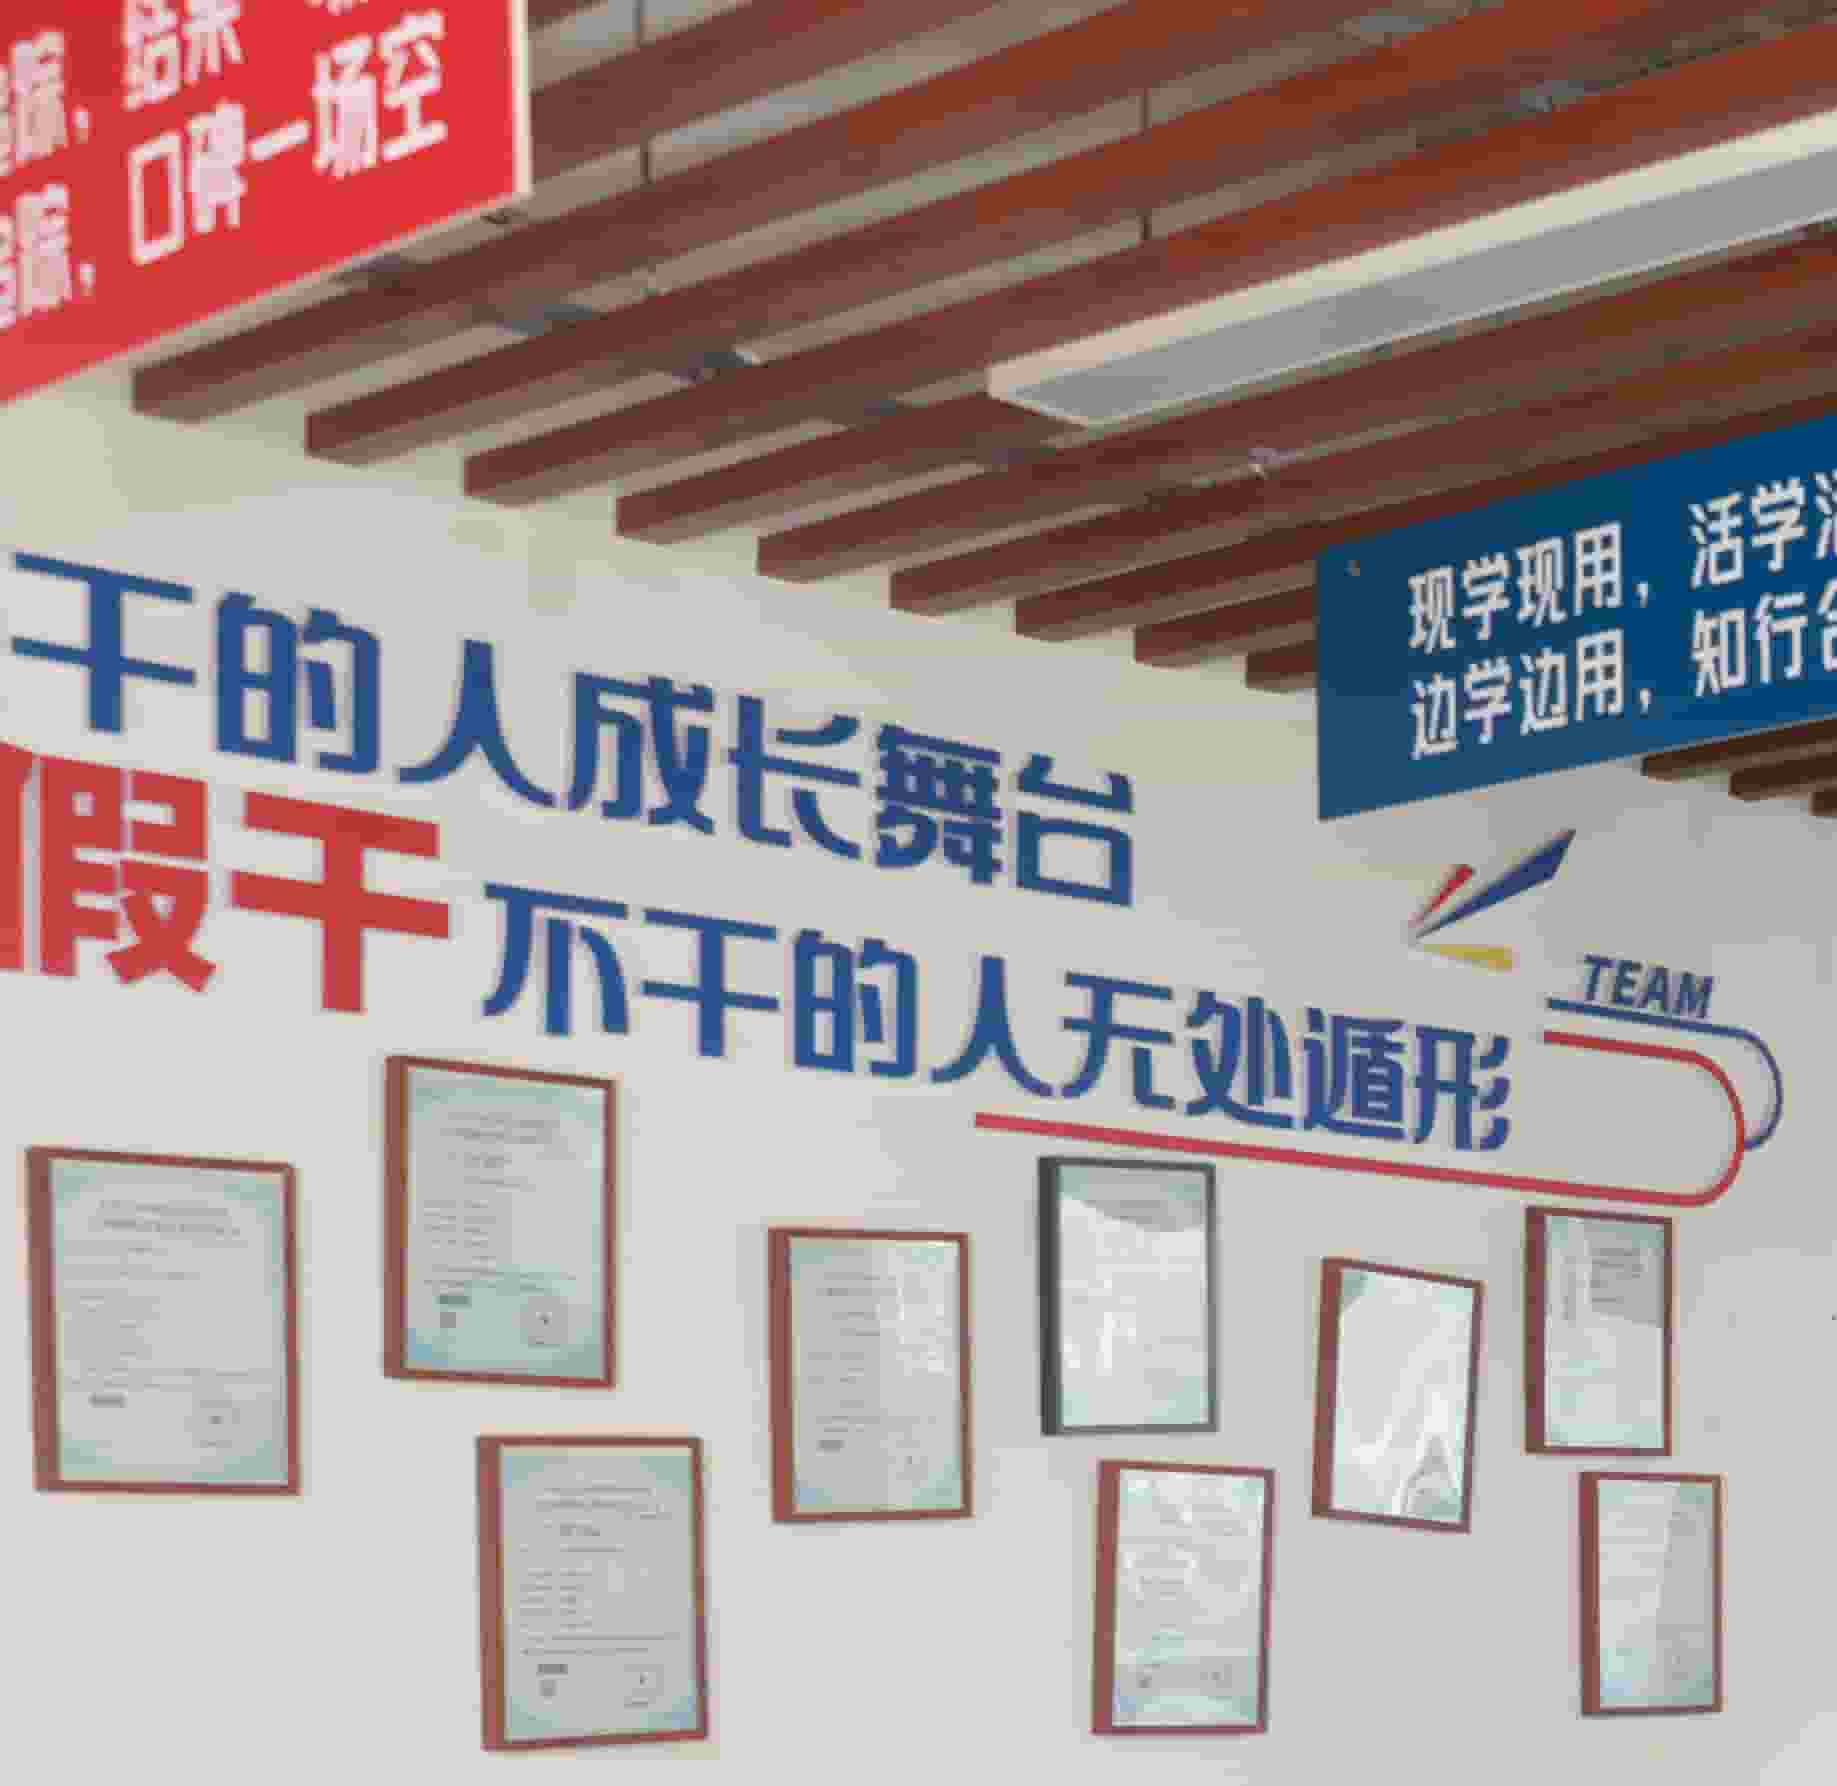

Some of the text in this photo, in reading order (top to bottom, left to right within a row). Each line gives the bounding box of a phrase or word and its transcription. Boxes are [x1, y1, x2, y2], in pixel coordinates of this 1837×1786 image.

[10, 550, 1134, 908] 干的人成长舞台
[1581, 952, 1714, 1021] TEAM
